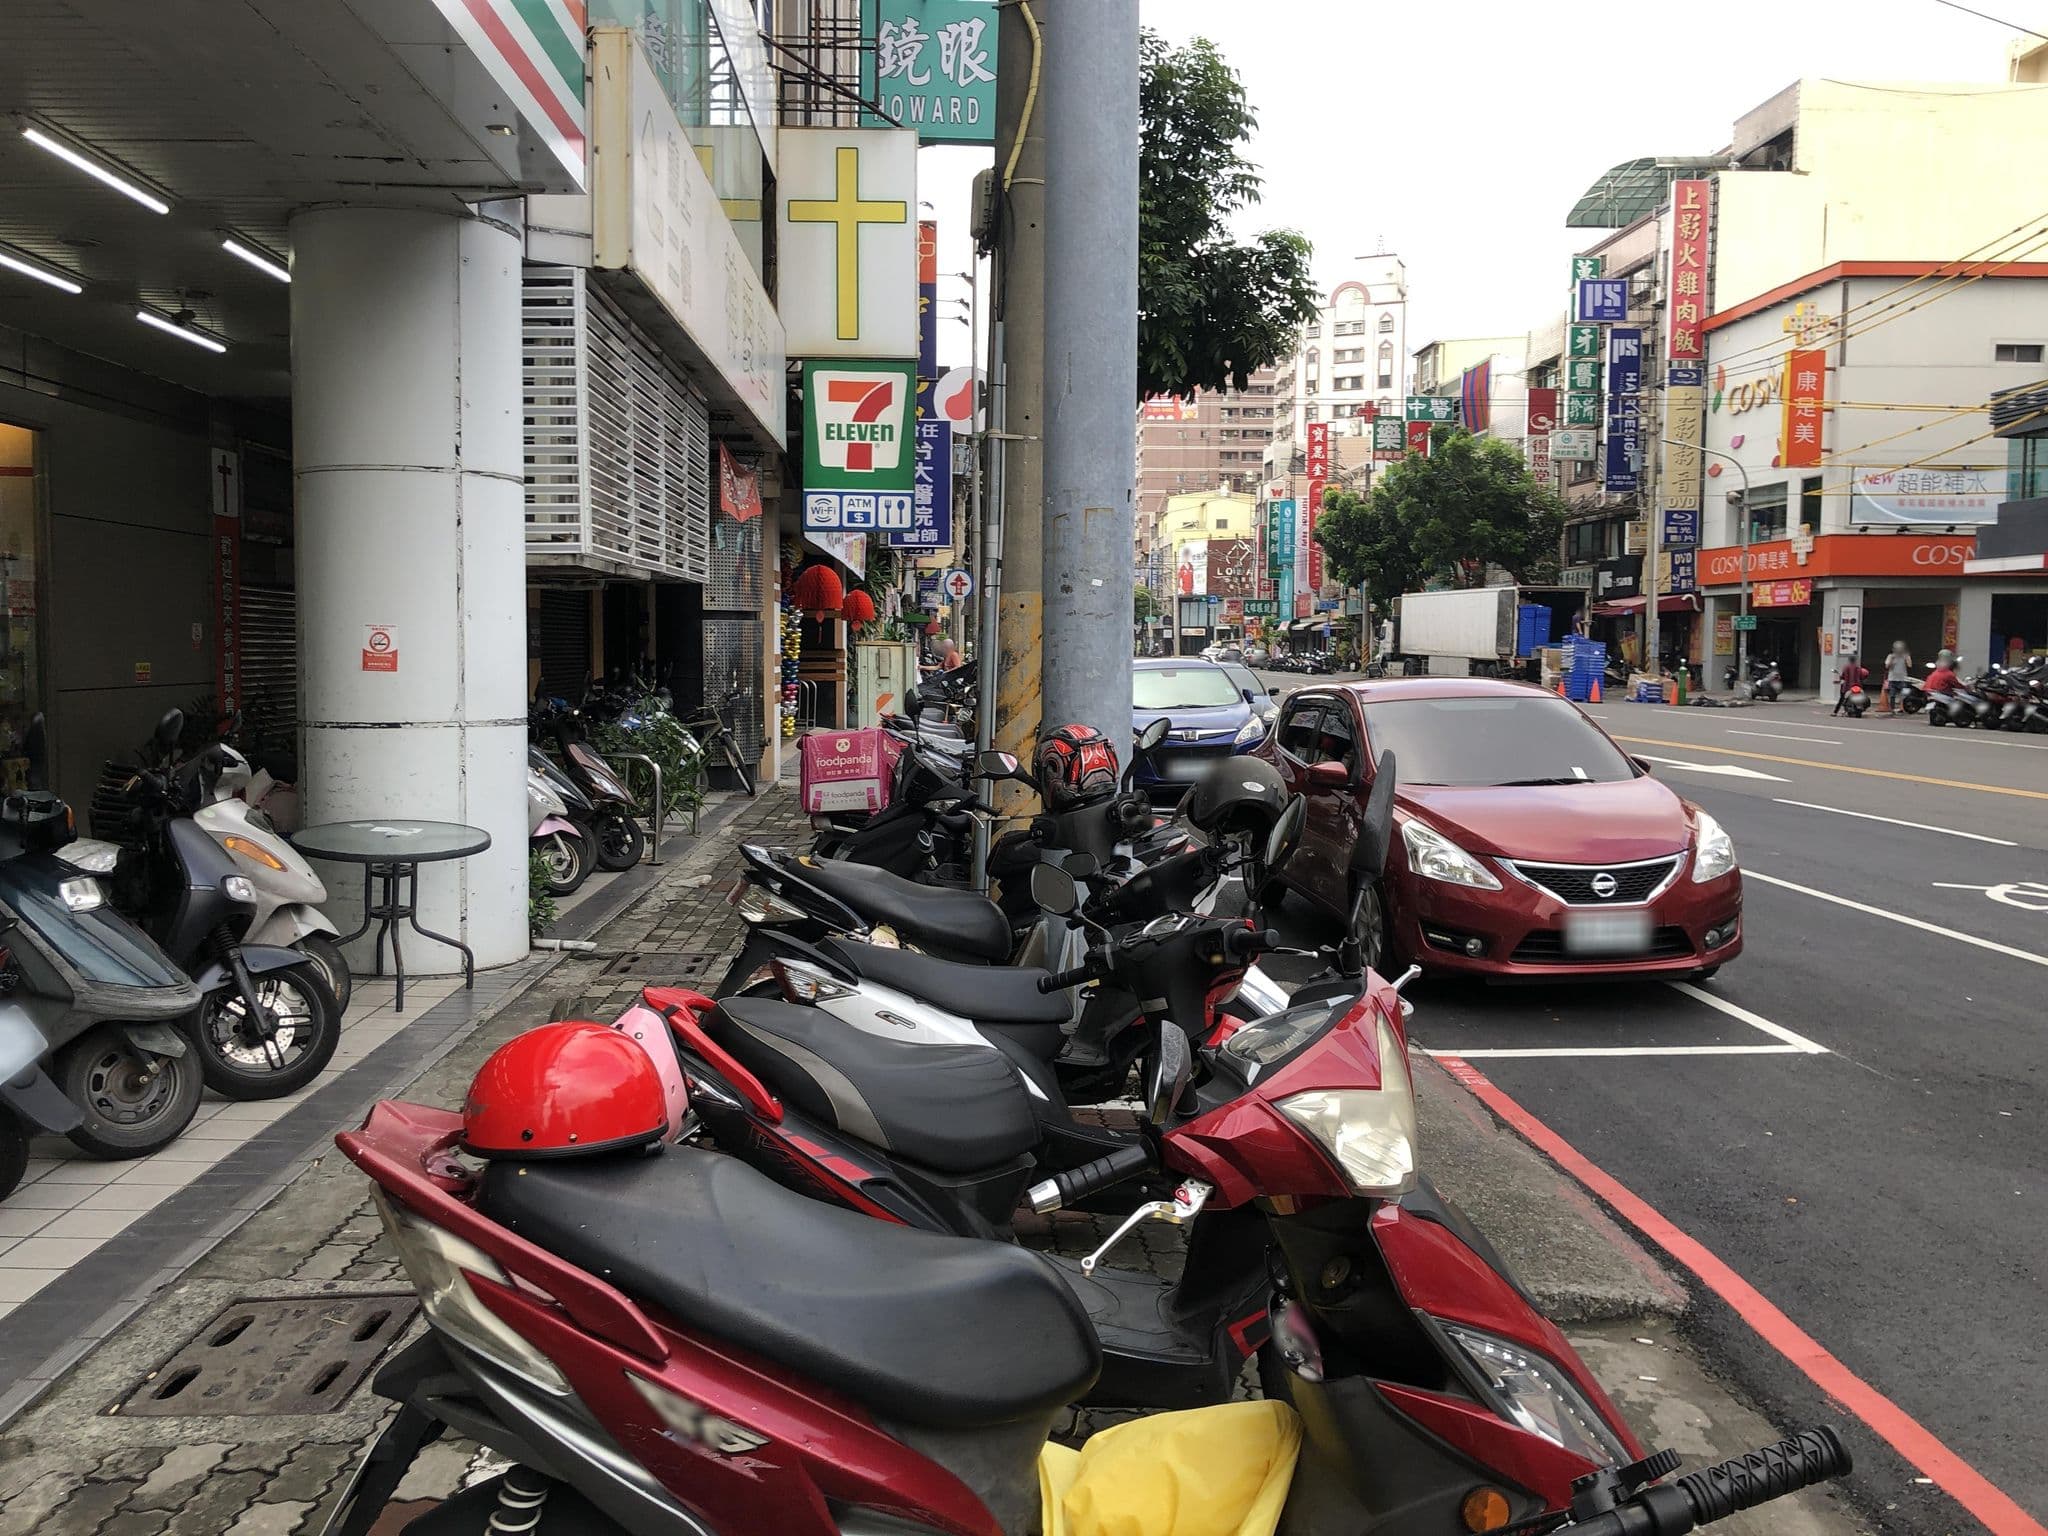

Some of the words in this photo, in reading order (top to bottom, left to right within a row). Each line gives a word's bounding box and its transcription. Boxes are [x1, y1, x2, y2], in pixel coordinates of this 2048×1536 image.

[873, 95, 981, 124] HOWARD
[1673, 186, 1703, 354] 上影火雞肉飯
[1407, 398, 1452, 419] 中醫
[1794, 371, 1818, 444] 康是美
[915, 423, 939, 438] 任
[1377, 419, 1401, 449] 藥
[1863, 474, 1895, 485] NEW
[1897, 473, 1987, 493] 超能補水
[811, 506, 837, 515] Wi-Fi
[847, 499, 872, 508] ATM
[1668, 497, 1696, 508] DVD
[1711, 553, 1757, 575] COSMD
[1758, 550, 1789, 570] 康是美
[816, 754, 873, 767] foodpanda
